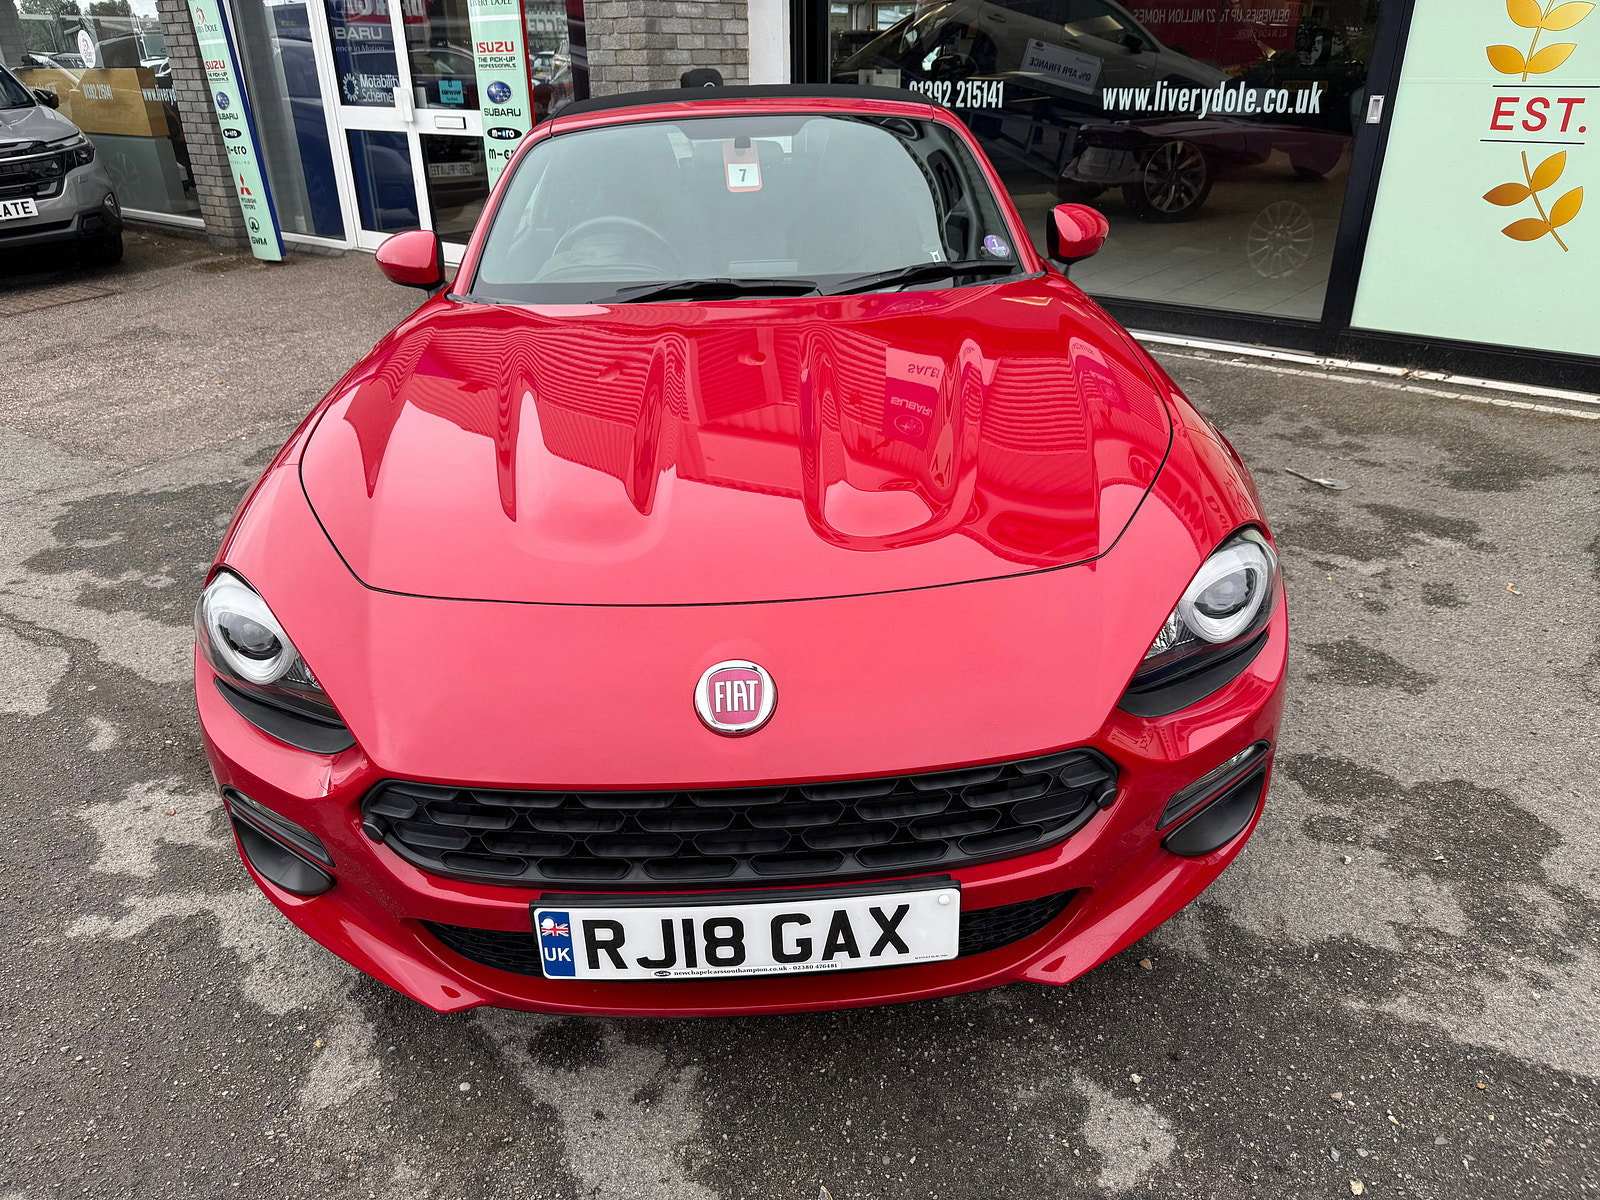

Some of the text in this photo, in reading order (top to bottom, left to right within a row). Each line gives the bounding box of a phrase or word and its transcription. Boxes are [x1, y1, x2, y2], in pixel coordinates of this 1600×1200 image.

[332, 26, 383, 40] BARU
[476, 41, 515, 53] ISUZU
[362, 88, 395, 103] Scheme
[956, 81, 1004, 109] 215141
[1103, 81, 1323, 119] www.liverydole.co.uk
[484, 108, 521, 117] SUBARU
[1490, 97, 1587, 133] EST.
[739, 168, 747, 182] 7
[0, 201, 33, 217] ATE
[715, 680, 759, 713] FIAT
[581, 904, 910, 970] RJ18 GAX
[544, 946, 572, 963] UK
[673, 965, 788, 976] newchapelcarssouthampton.co.uk
